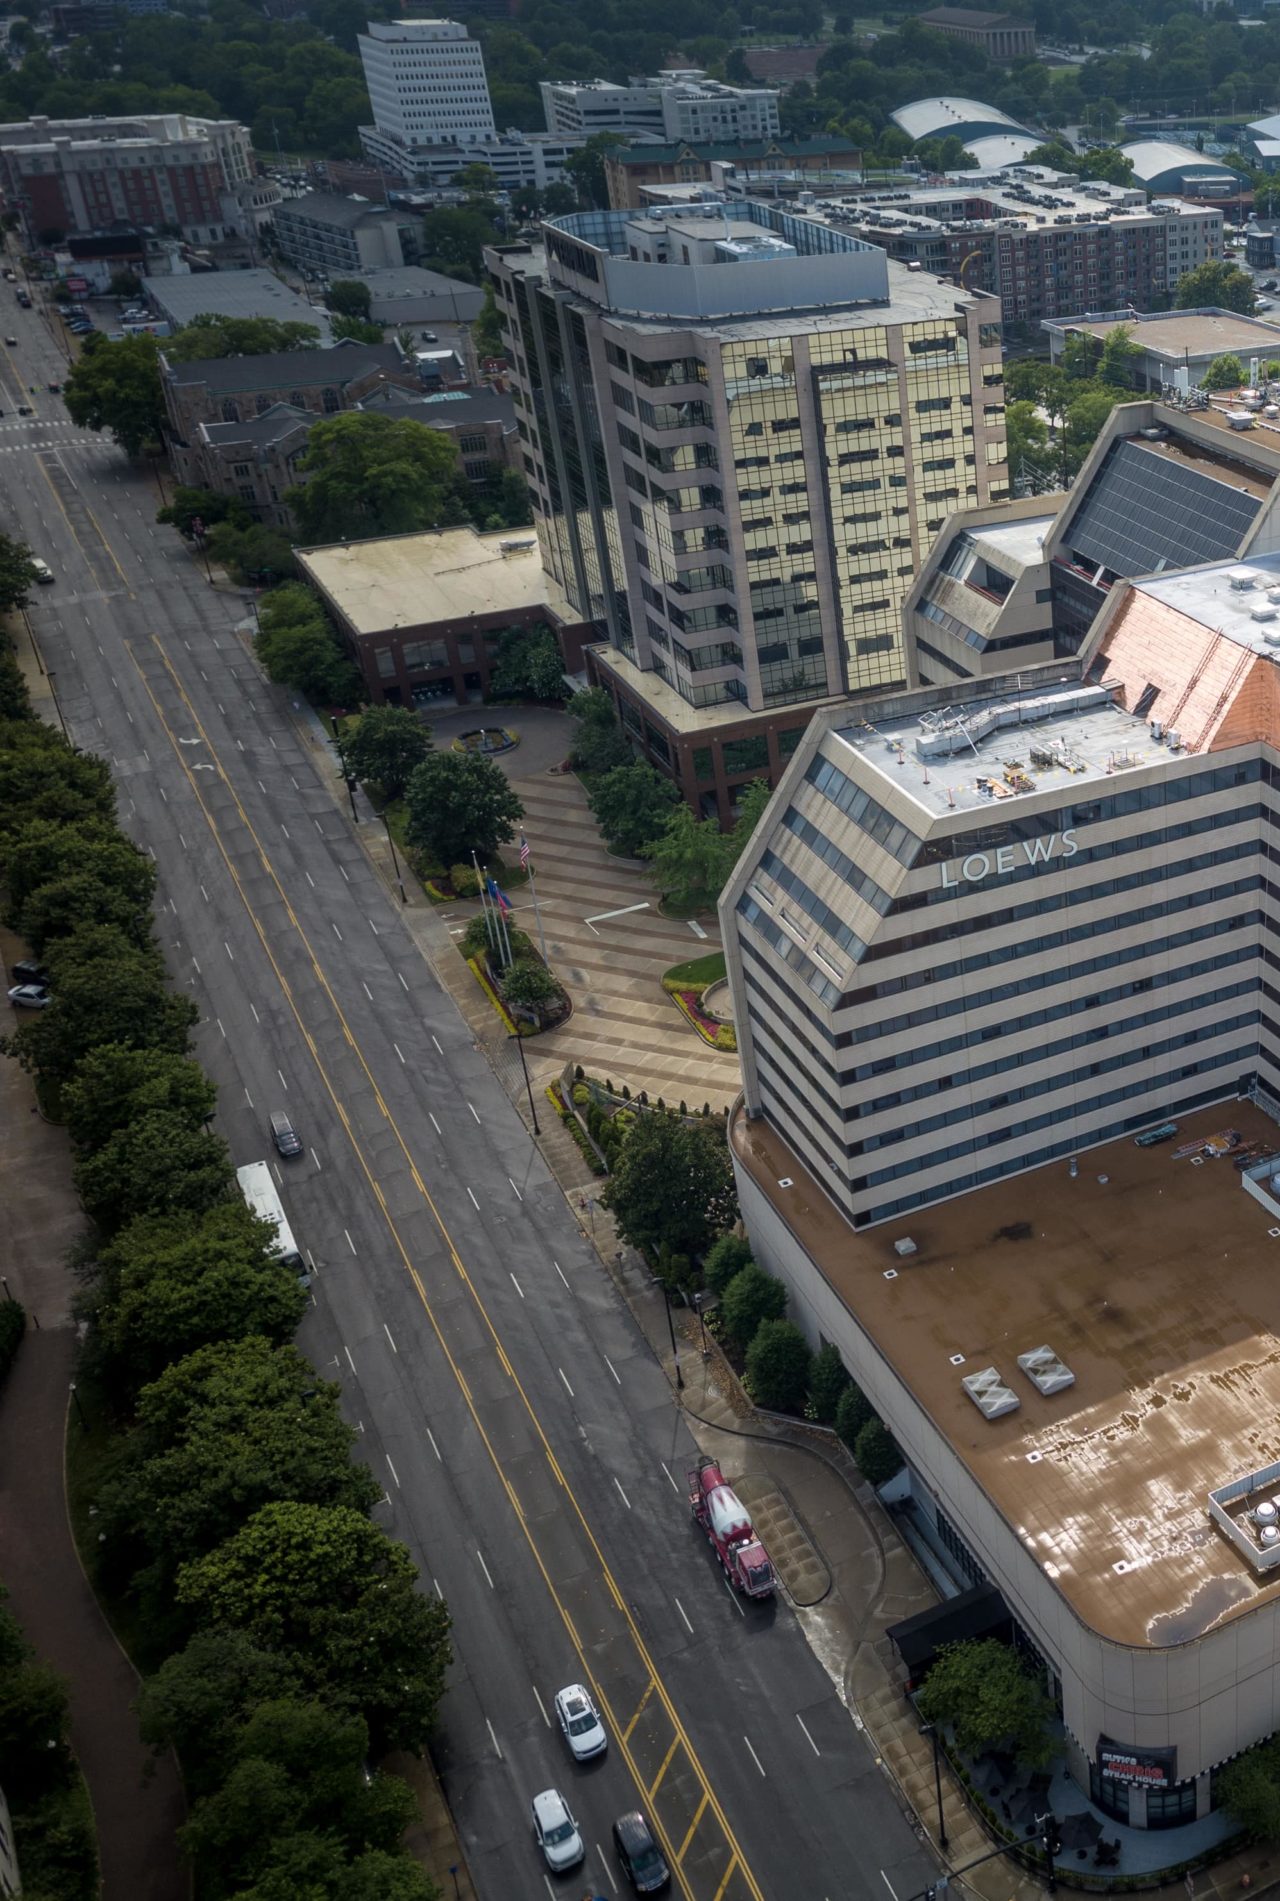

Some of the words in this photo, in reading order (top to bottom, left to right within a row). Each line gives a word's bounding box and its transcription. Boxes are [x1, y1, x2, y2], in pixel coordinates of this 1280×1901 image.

[940, 829, 1079, 889] LOEWS
[1102, 1768, 1134, 1781] STEAK
[1134, 1774, 1169, 1787] HOUSE
[1108, 1762, 1164, 1780] CHRIS
